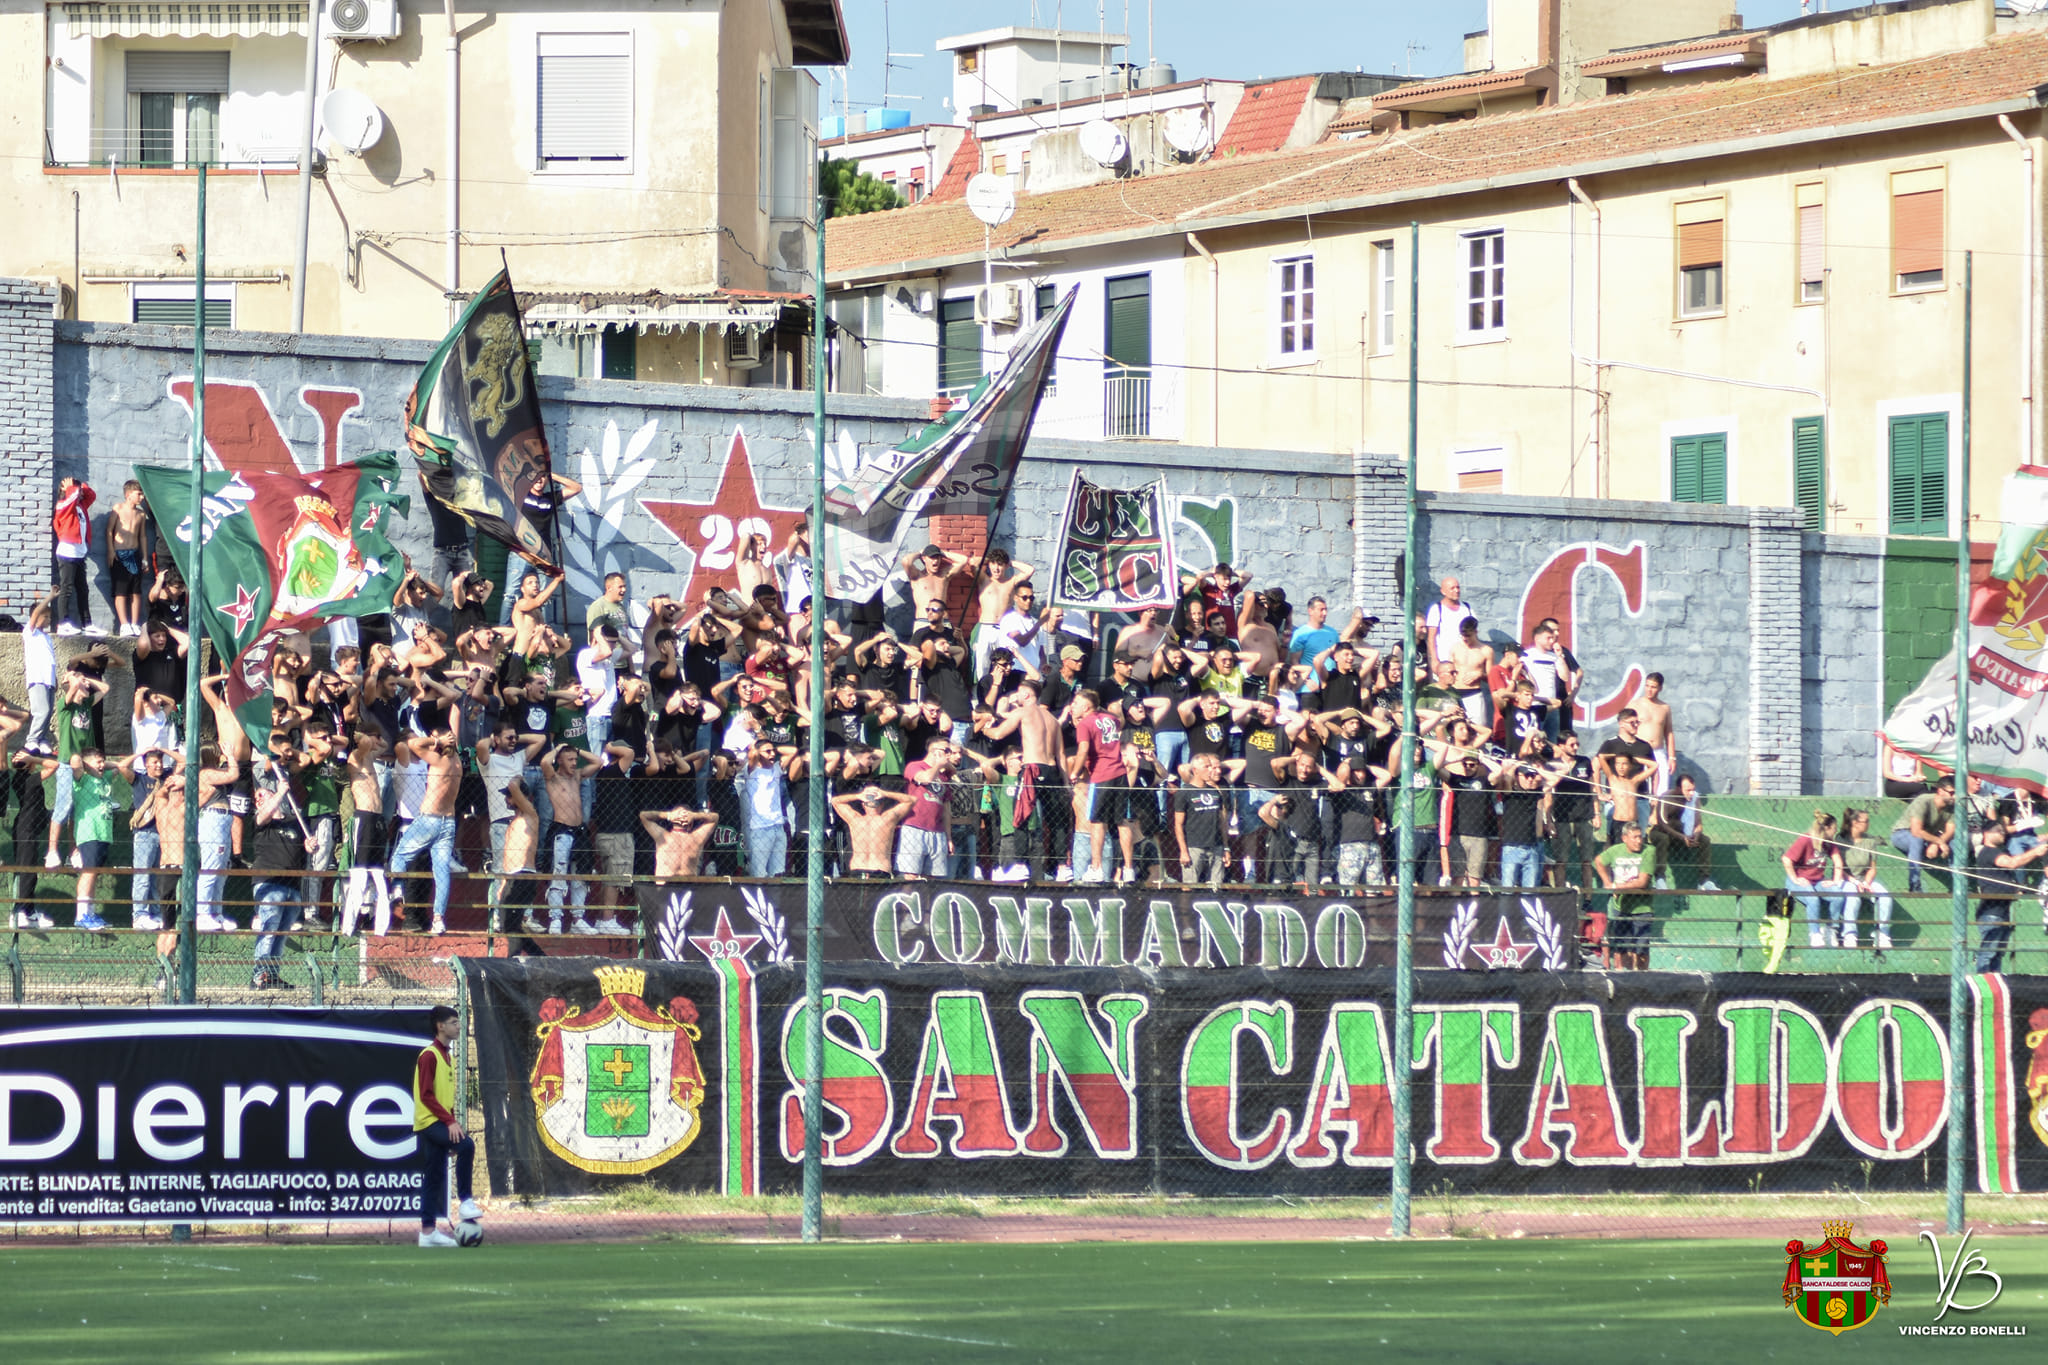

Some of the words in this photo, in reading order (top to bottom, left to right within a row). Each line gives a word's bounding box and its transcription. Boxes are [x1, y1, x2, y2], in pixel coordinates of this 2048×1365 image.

[1517, 540, 1647, 729] C
[709, 940, 743, 961] 22
[874, 892, 1366, 969] COMMANDO
[1489, 947, 1520, 969] 22
[780, 987, 1149, 1167] SAN
[1180, 998, 1953, 1170] CATALDO
[0, 1074, 418, 1161] Dierre
[38, 1175, 125, 1193] BLINDATE,
[130, 1175, 206, 1192] INTERNE,
[210, 1174, 331, 1191] TAGLIAFUOCO,
[336, 1173, 360, 1188] DA
[364, 1173, 425, 1189] GARAG
[38, 1198, 54, 1214] di
[58, 1198, 124, 1214] vendita:
[128, 1198, 197, 1214] Gaetano
[201, 1198, 273, 1216] Vivacqua
[289, 1196, 326, 1212] info:
